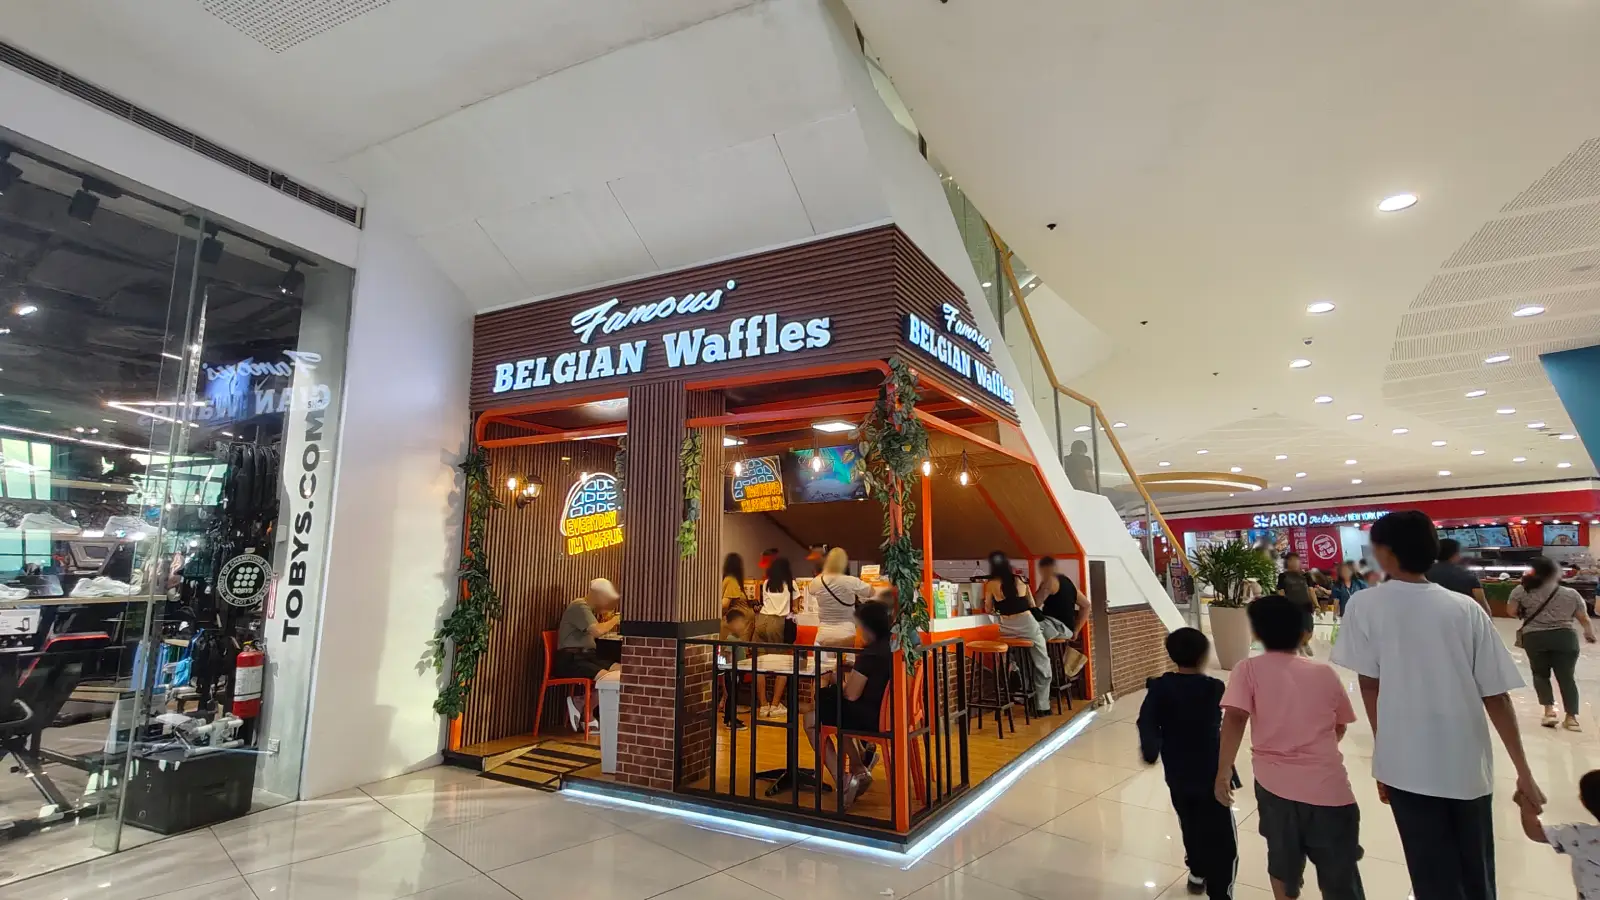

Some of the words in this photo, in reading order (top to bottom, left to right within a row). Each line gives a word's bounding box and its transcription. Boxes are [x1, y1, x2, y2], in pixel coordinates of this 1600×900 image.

[493, 339, 647, 393] BELGIAN
[662, 313, 832, 368] Waffles
[571, 288, 723, 344] Famous
[942, 303, 992, 352] Famous
[909, 312, 971, 379] BELGIAN
[975, 360, 1015, 405] Waffles
[282, 409, 325, 643] TOBYS.COM
